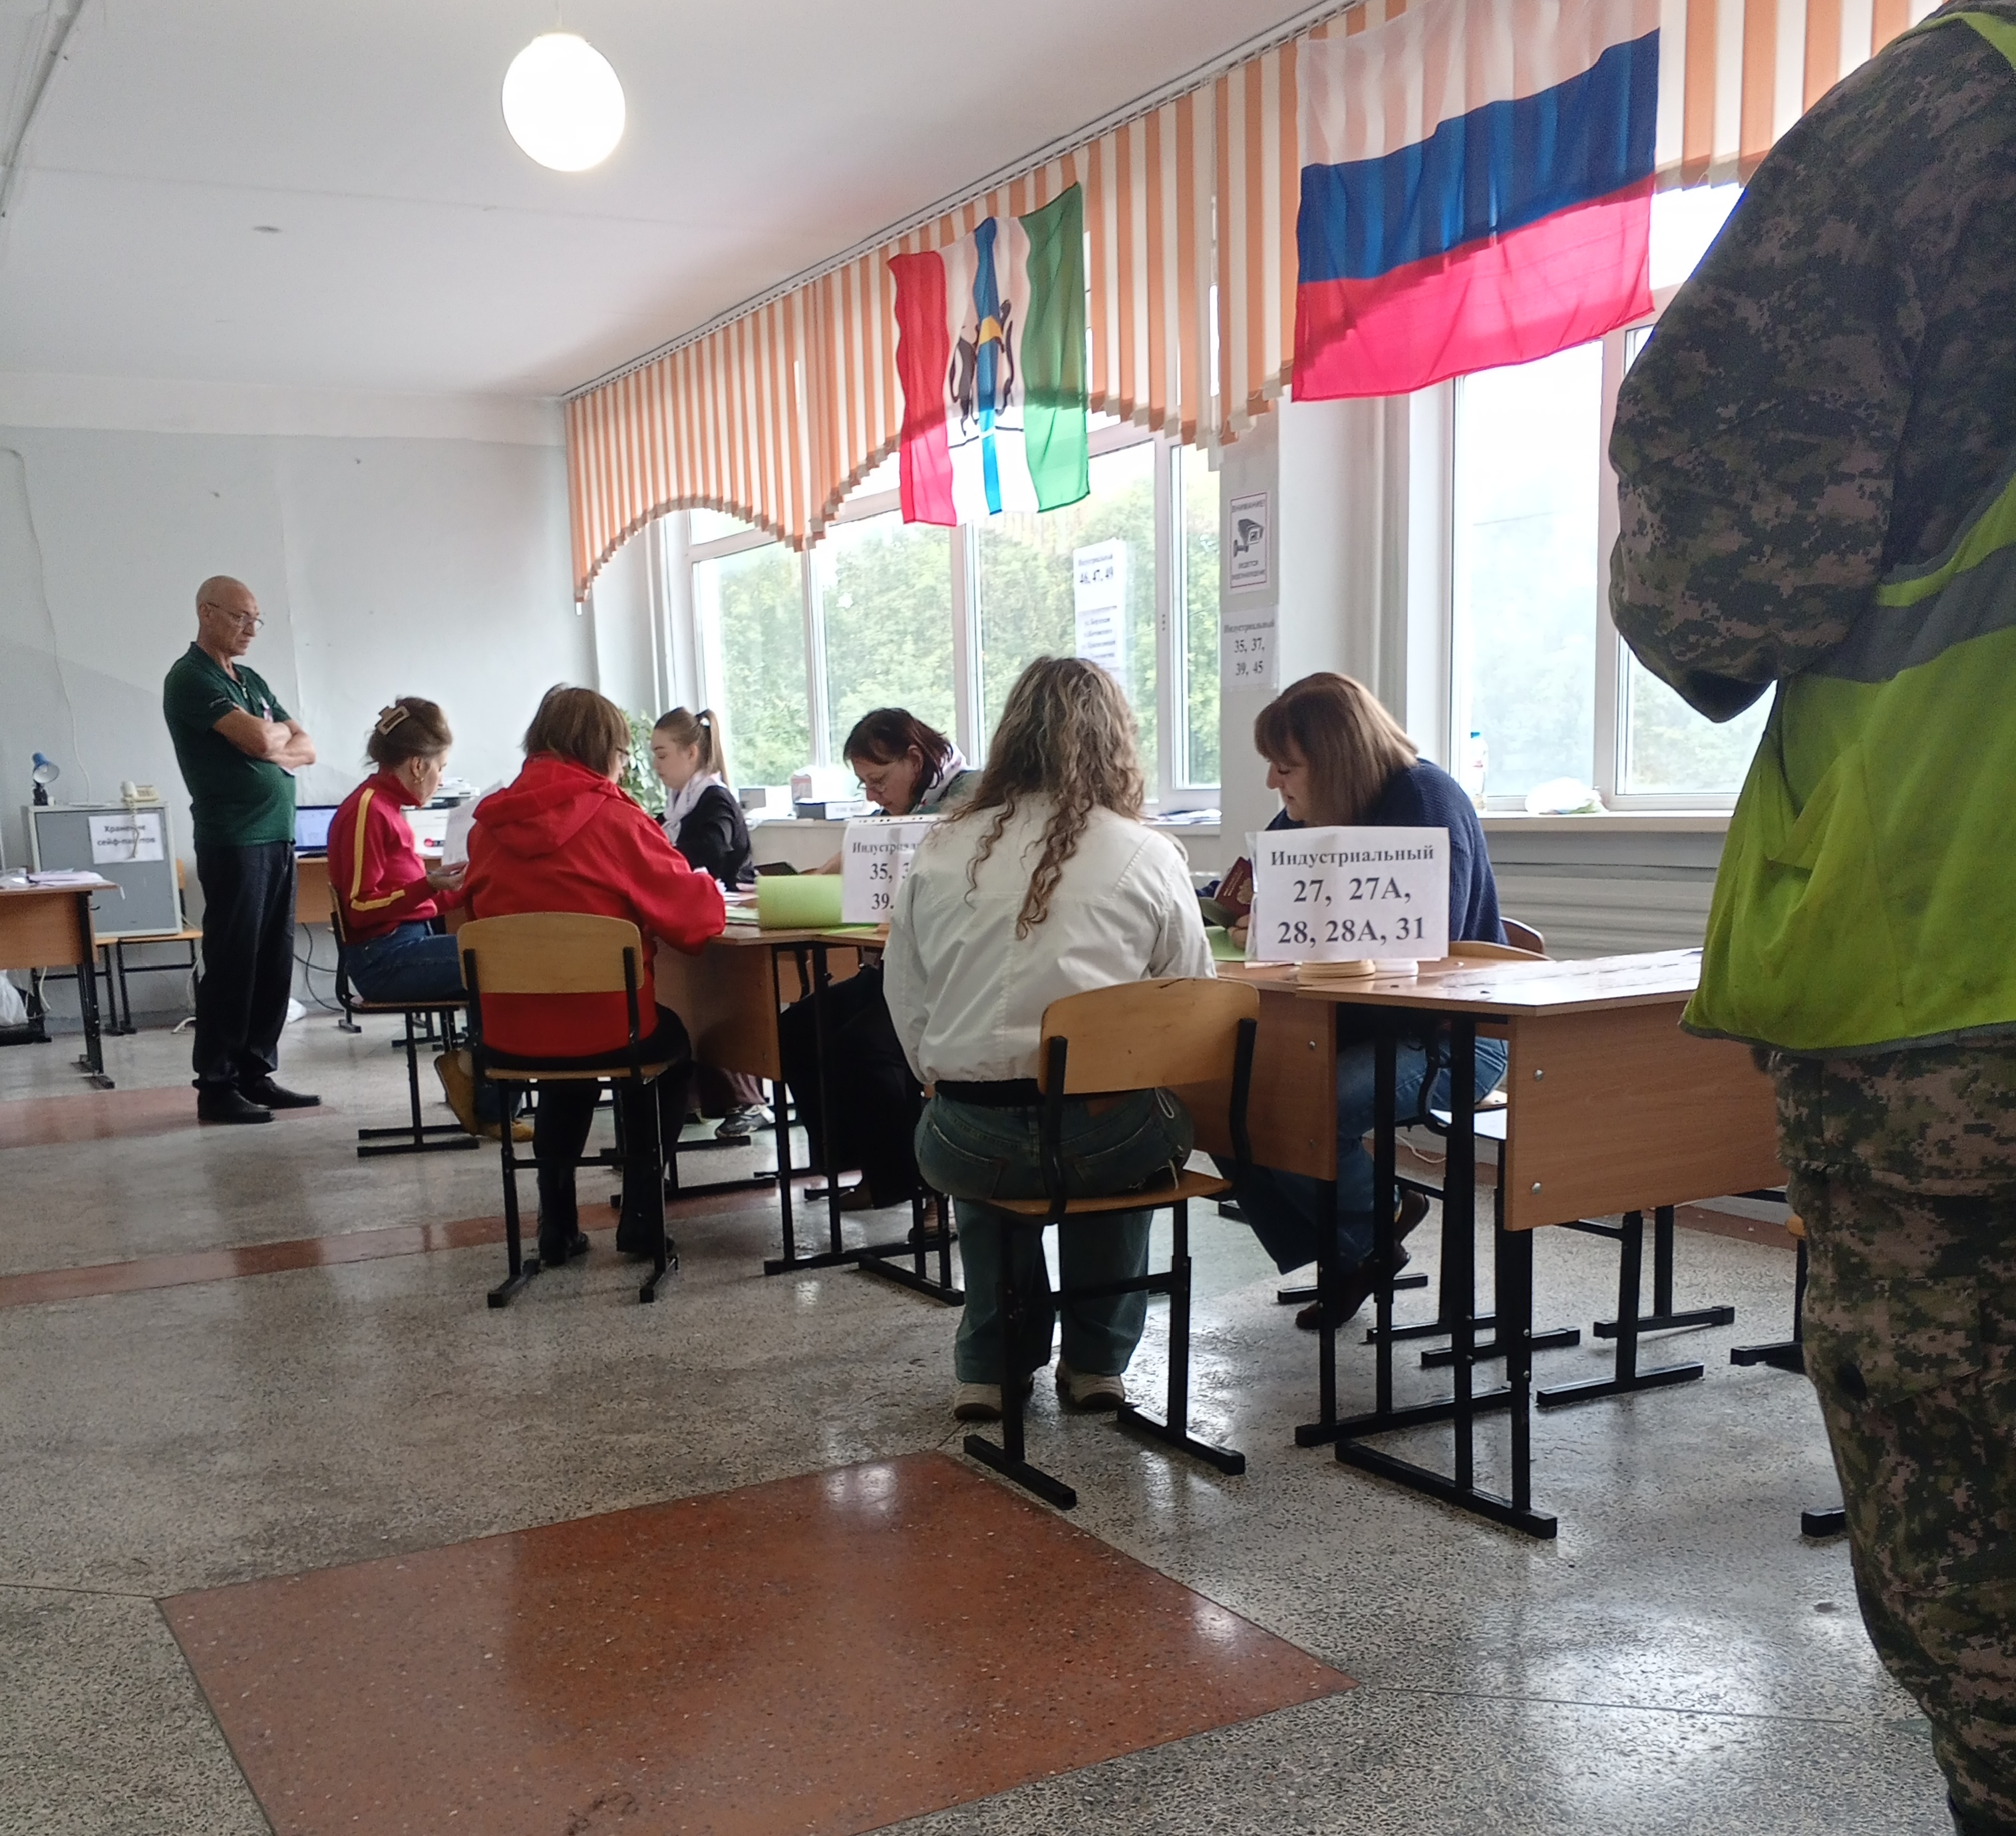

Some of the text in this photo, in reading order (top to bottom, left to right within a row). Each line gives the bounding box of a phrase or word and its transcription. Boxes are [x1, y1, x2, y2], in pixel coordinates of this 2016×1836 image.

[1234, 637, 1265, 653] 35, 37,
[1253, 660, 1263, 674] 45
[1271, 845, 1434, 867] Индустриальный
[870, 862, 893, 884] 35,
[1293, 877, 1411, 906] 27, 27А,
[1277, 917, 1425, 948] 28, 28А, 31
